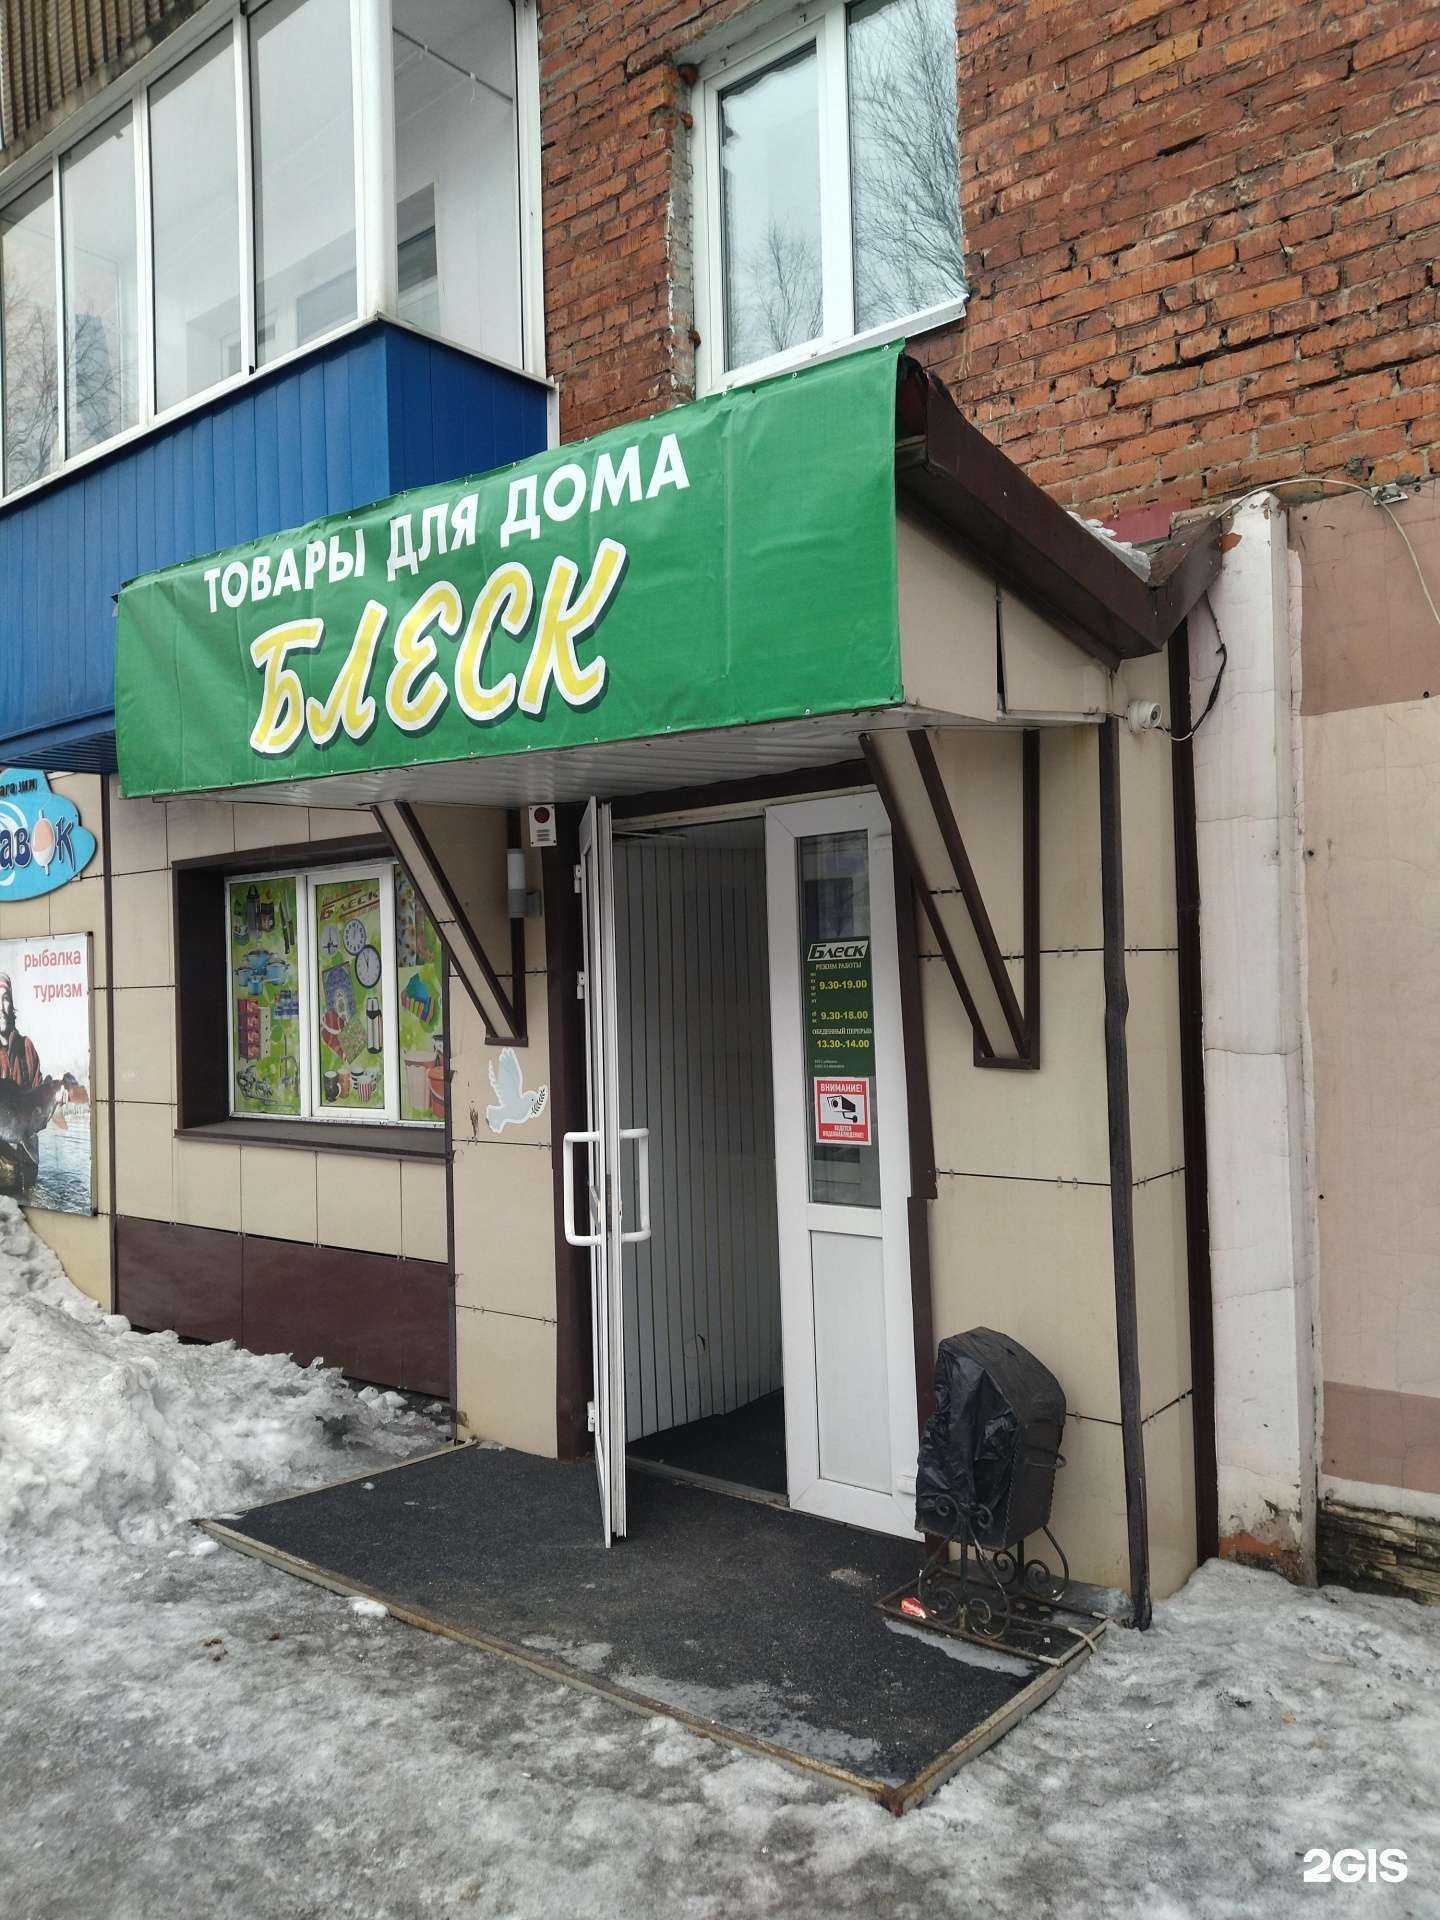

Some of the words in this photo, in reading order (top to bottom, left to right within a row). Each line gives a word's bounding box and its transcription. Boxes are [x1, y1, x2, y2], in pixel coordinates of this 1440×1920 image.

[204, 529, 366, 613] ТОВАРЫ
[387, 493, 480, 582] ДЛЯ
[499, 433, 690, 548] ДОМА
[249, 537, 628, 756] БЛЕСК
[24, 948, 81, 972] рыбалка
[33, 982, 82, 1002] туризм
[819, 979, 868, 990] 9.30-19.00
[820, 1083, 863, 1093] ВНИМАНИЕ!
